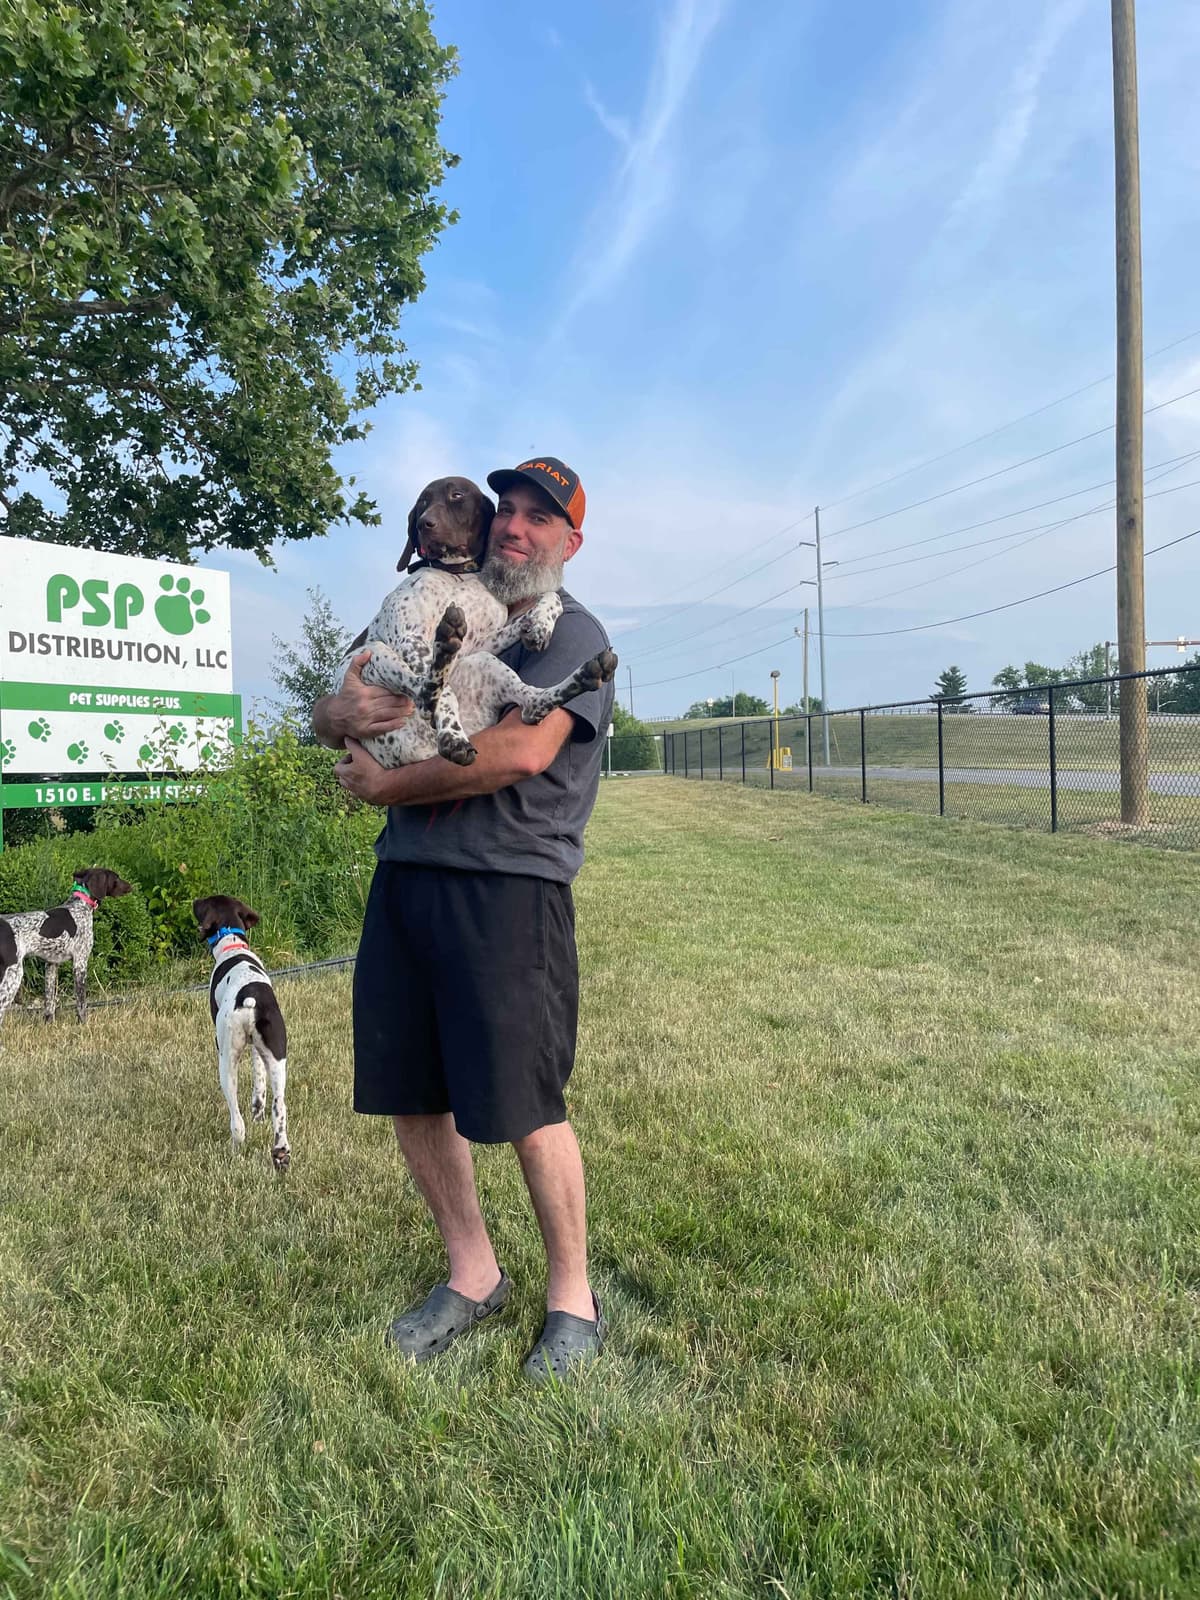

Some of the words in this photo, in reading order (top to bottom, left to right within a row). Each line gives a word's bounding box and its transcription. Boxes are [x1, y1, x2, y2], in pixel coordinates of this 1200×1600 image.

[46, 573, 145, 630] PSP
[8, 631, 188, 669] DISTRIBUTION,
[195, 648, 228, 669] LLC
[69, 692, 92, 705] PET
[95, 693, 150, 708] SUPPLIES
[35, 787, 78, 803] 1510
[82, 787, 96, 802] E.
